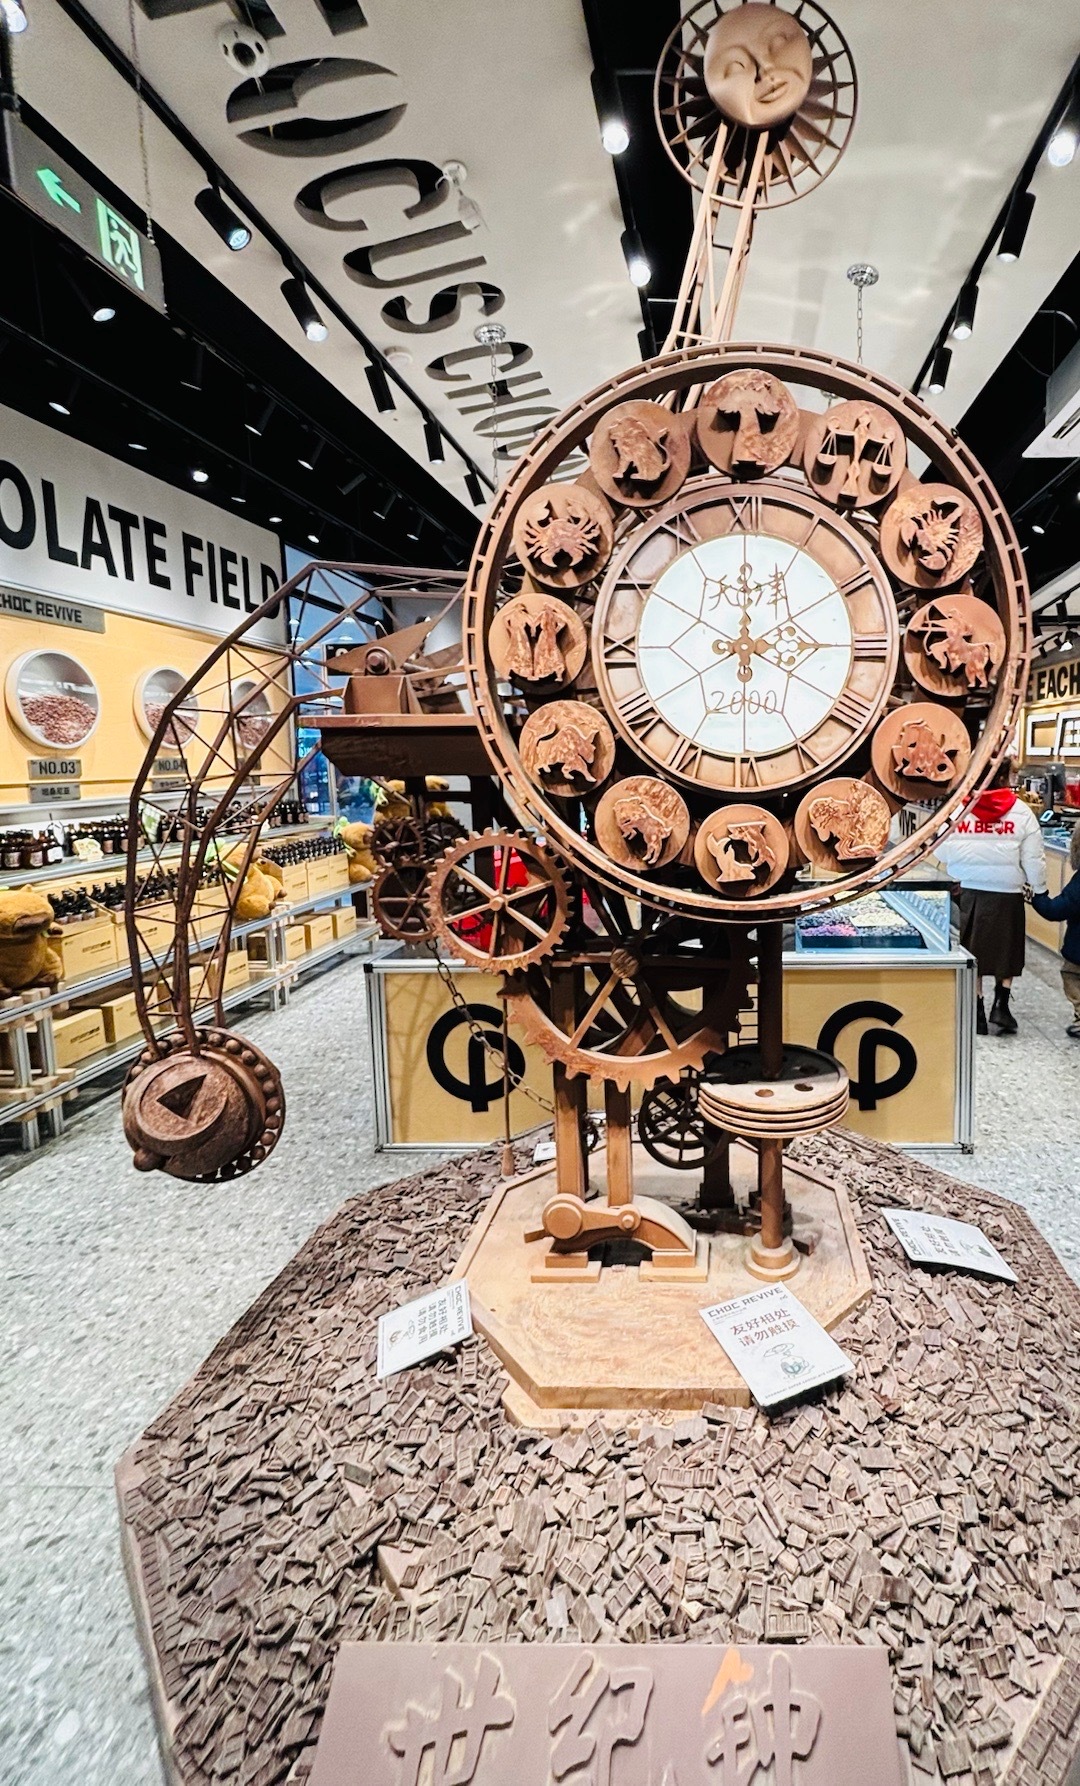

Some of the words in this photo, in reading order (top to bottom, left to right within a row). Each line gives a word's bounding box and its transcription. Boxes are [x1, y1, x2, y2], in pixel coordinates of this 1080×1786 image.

[182, 531, 279, 620] FIELD
[0, 593, 32, 613] HOC
[36, 600, 82, 623] REVIVE
[1037, 661, 1080, 700] EACH
[709, 690, 778, 715] 2000
[39, 761, 76, 775] NO.03
[708, 1302, 741, 1318] CHOC
[742, 1287, 783, 1307] REVIVE
[730, 1308, 791, 1335] 友好相处
[738, 1319, 800, 1347] 请勿触摸
